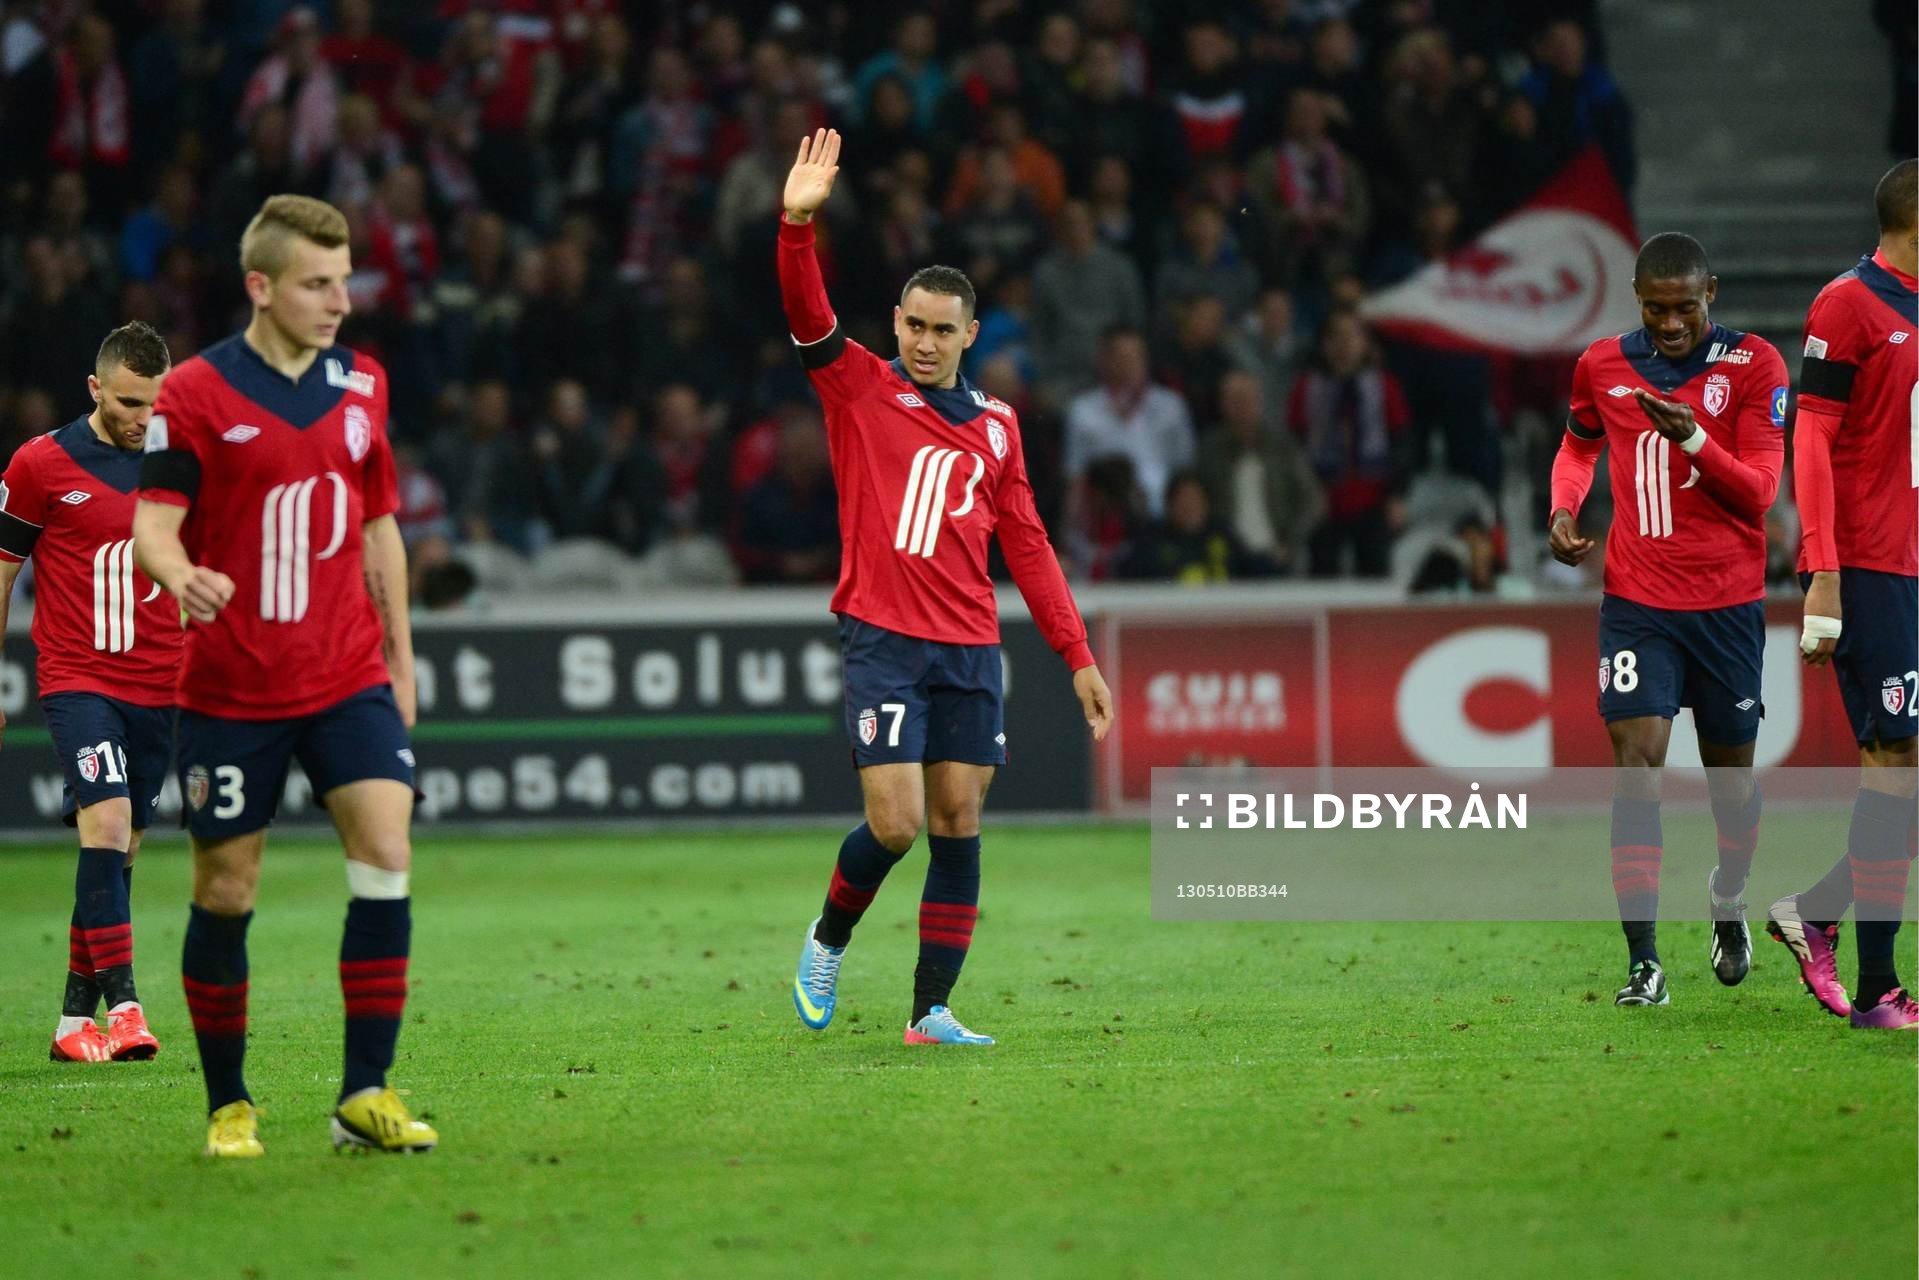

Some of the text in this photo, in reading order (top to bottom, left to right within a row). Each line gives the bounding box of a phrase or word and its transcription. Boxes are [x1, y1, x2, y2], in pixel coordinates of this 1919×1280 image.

[1613, 650, 1639, 692] 8
[881, 703, 906, 747] 7
[214, 764, 246, 820] 3
